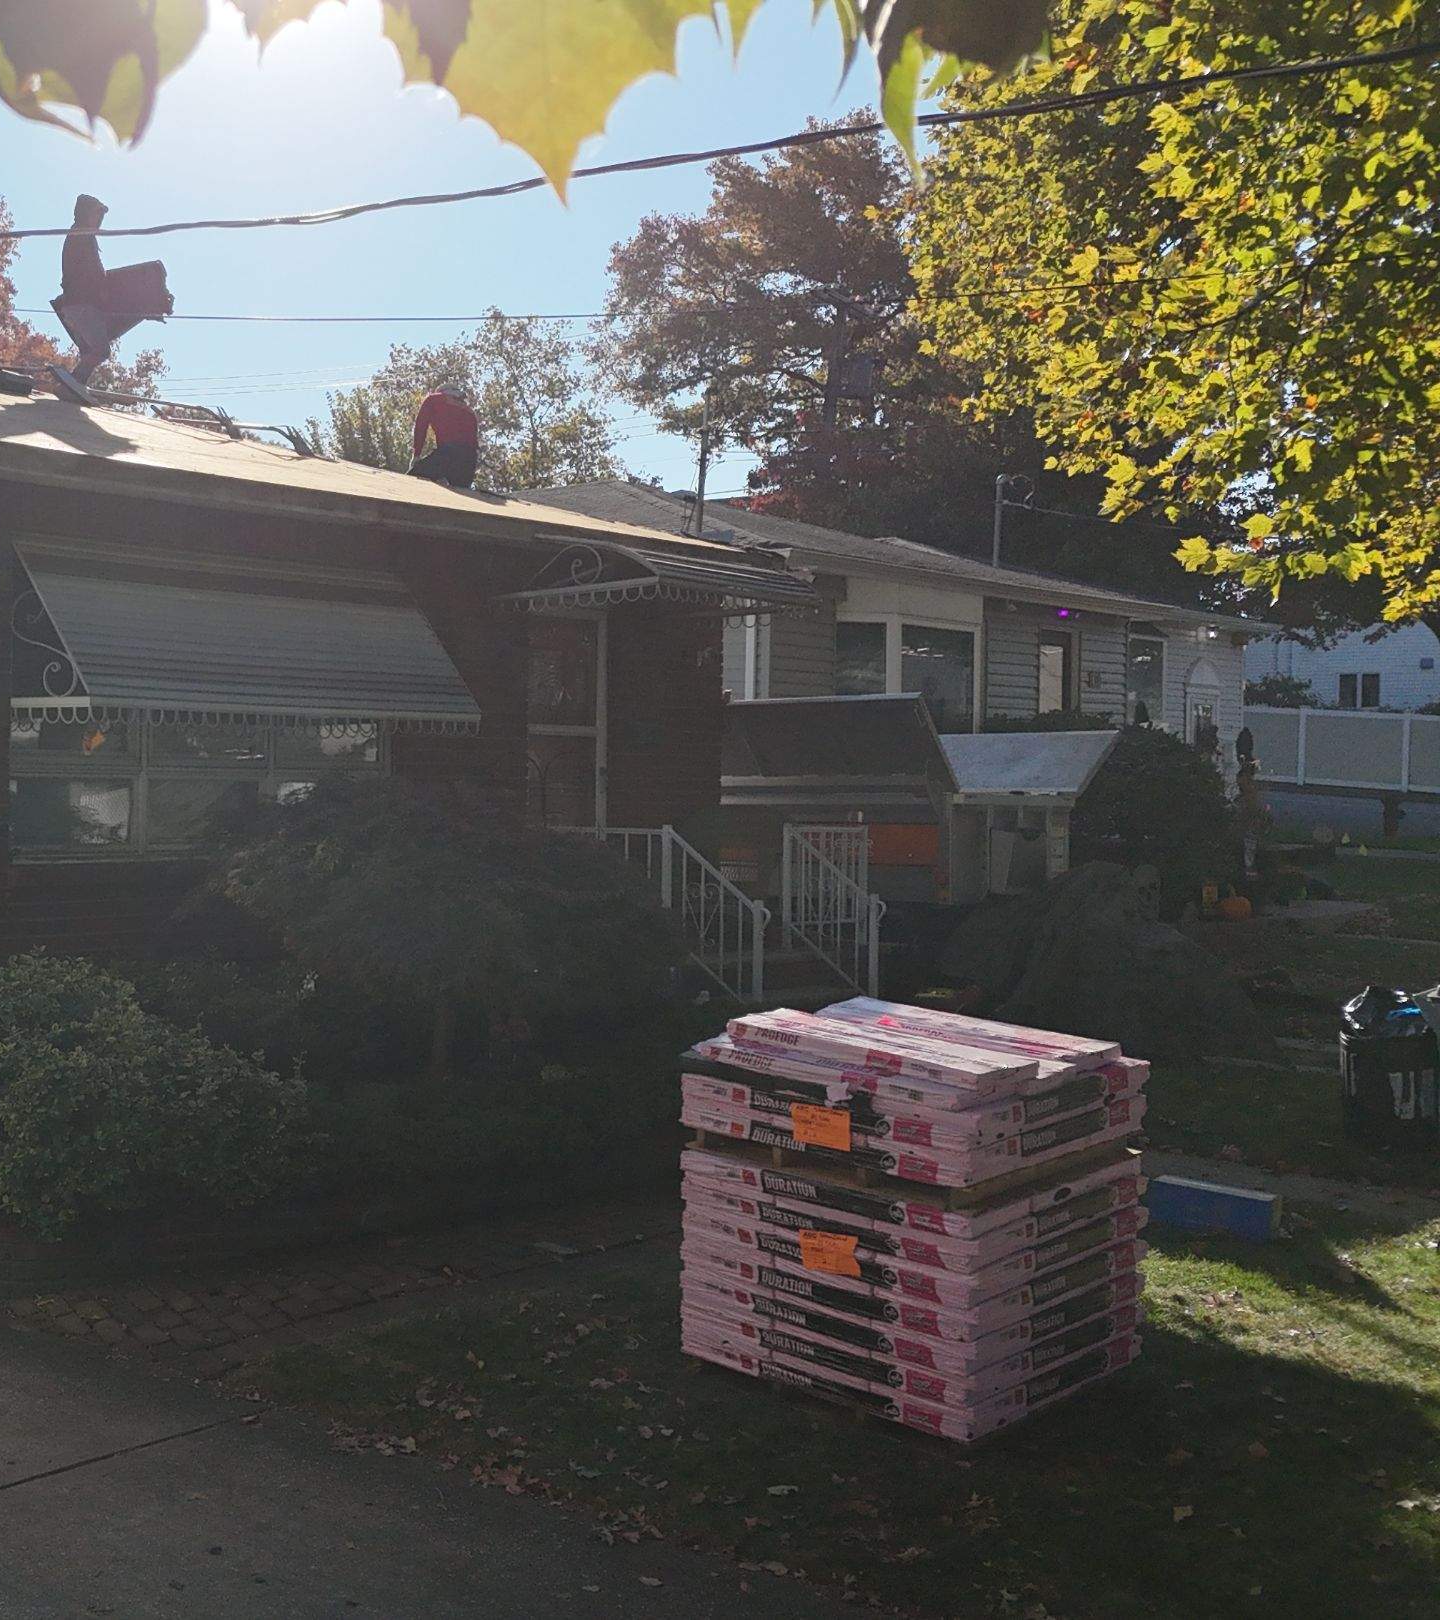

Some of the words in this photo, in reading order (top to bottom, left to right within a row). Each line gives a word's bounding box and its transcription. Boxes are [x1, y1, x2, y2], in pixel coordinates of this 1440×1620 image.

[752, 1129, 806, 1152] DURATION
[764, 1175, 817, 1199] DURATION
[762, 1269, 812, 1296] DURATION
